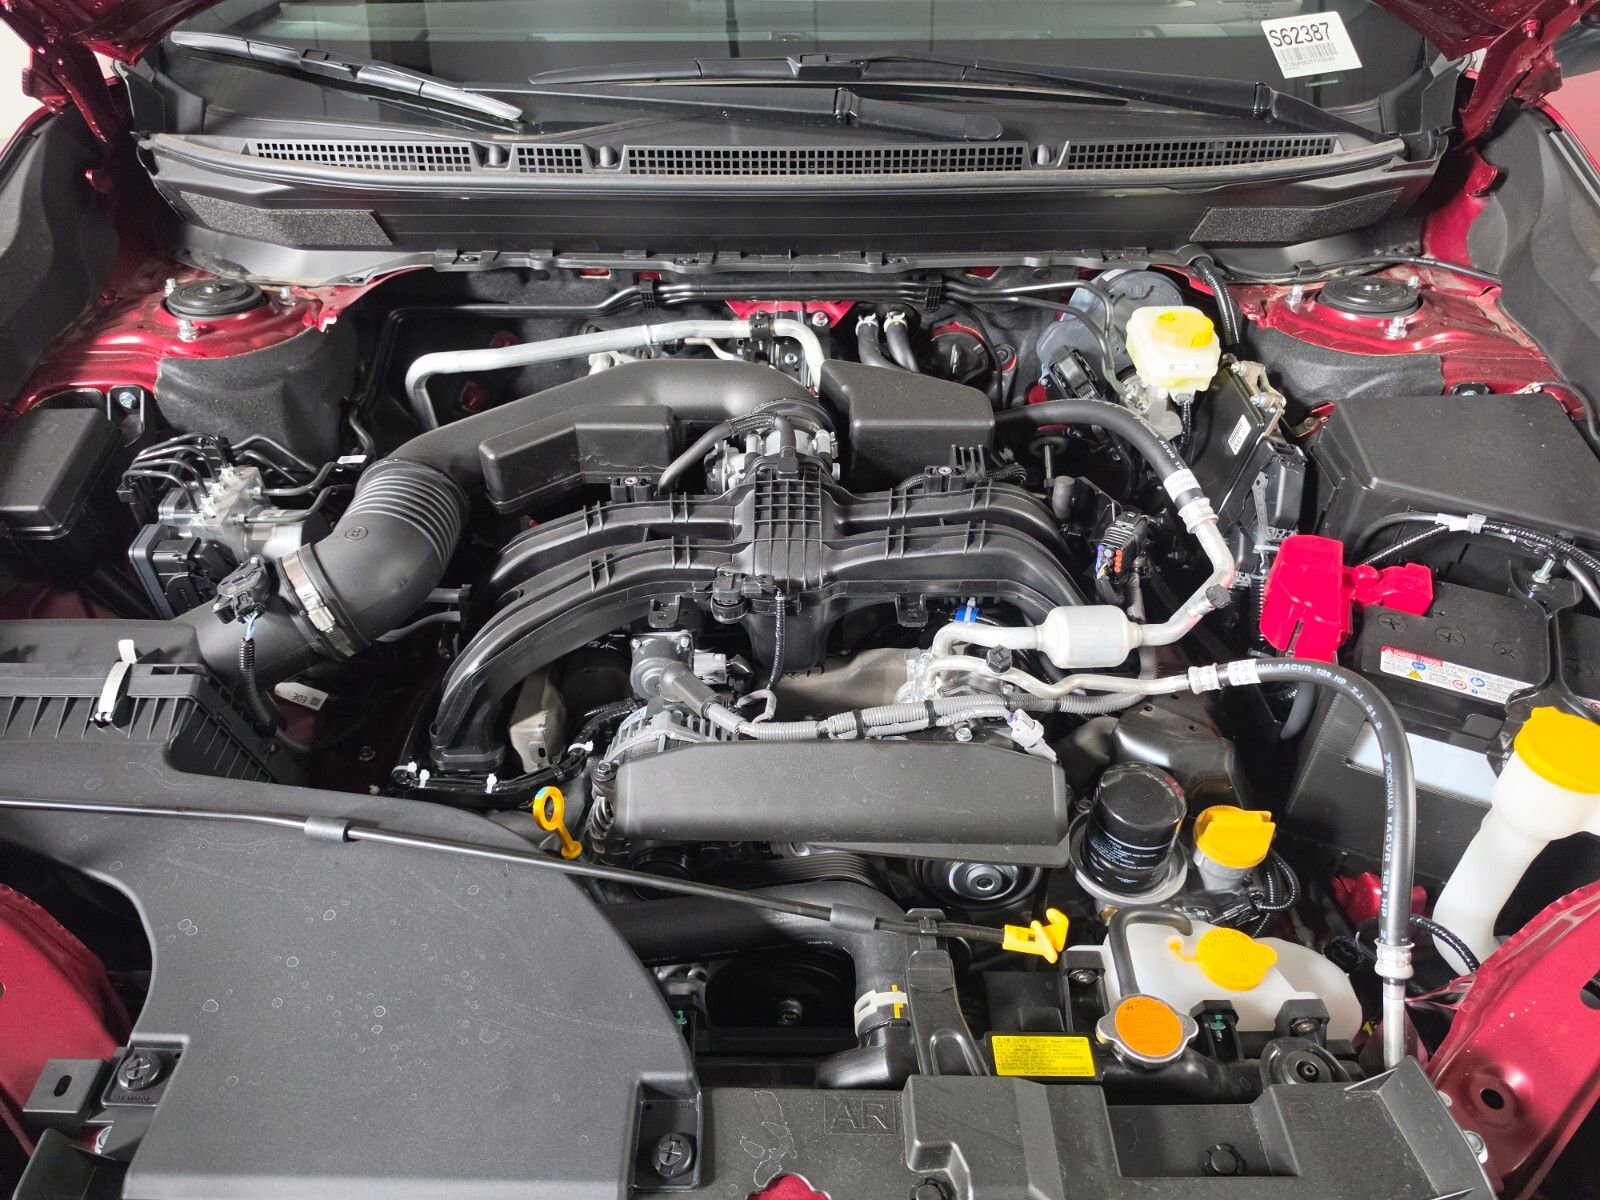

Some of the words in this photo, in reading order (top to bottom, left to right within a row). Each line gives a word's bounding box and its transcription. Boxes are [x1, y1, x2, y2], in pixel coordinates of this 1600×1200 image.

[1269, 22, 1329, 47] S62387
[1385, 763, 1394, 810] YOKOHAMA
[1381, 899, 1388, 917] HP
[830, 1101, 890, 1130] AR
